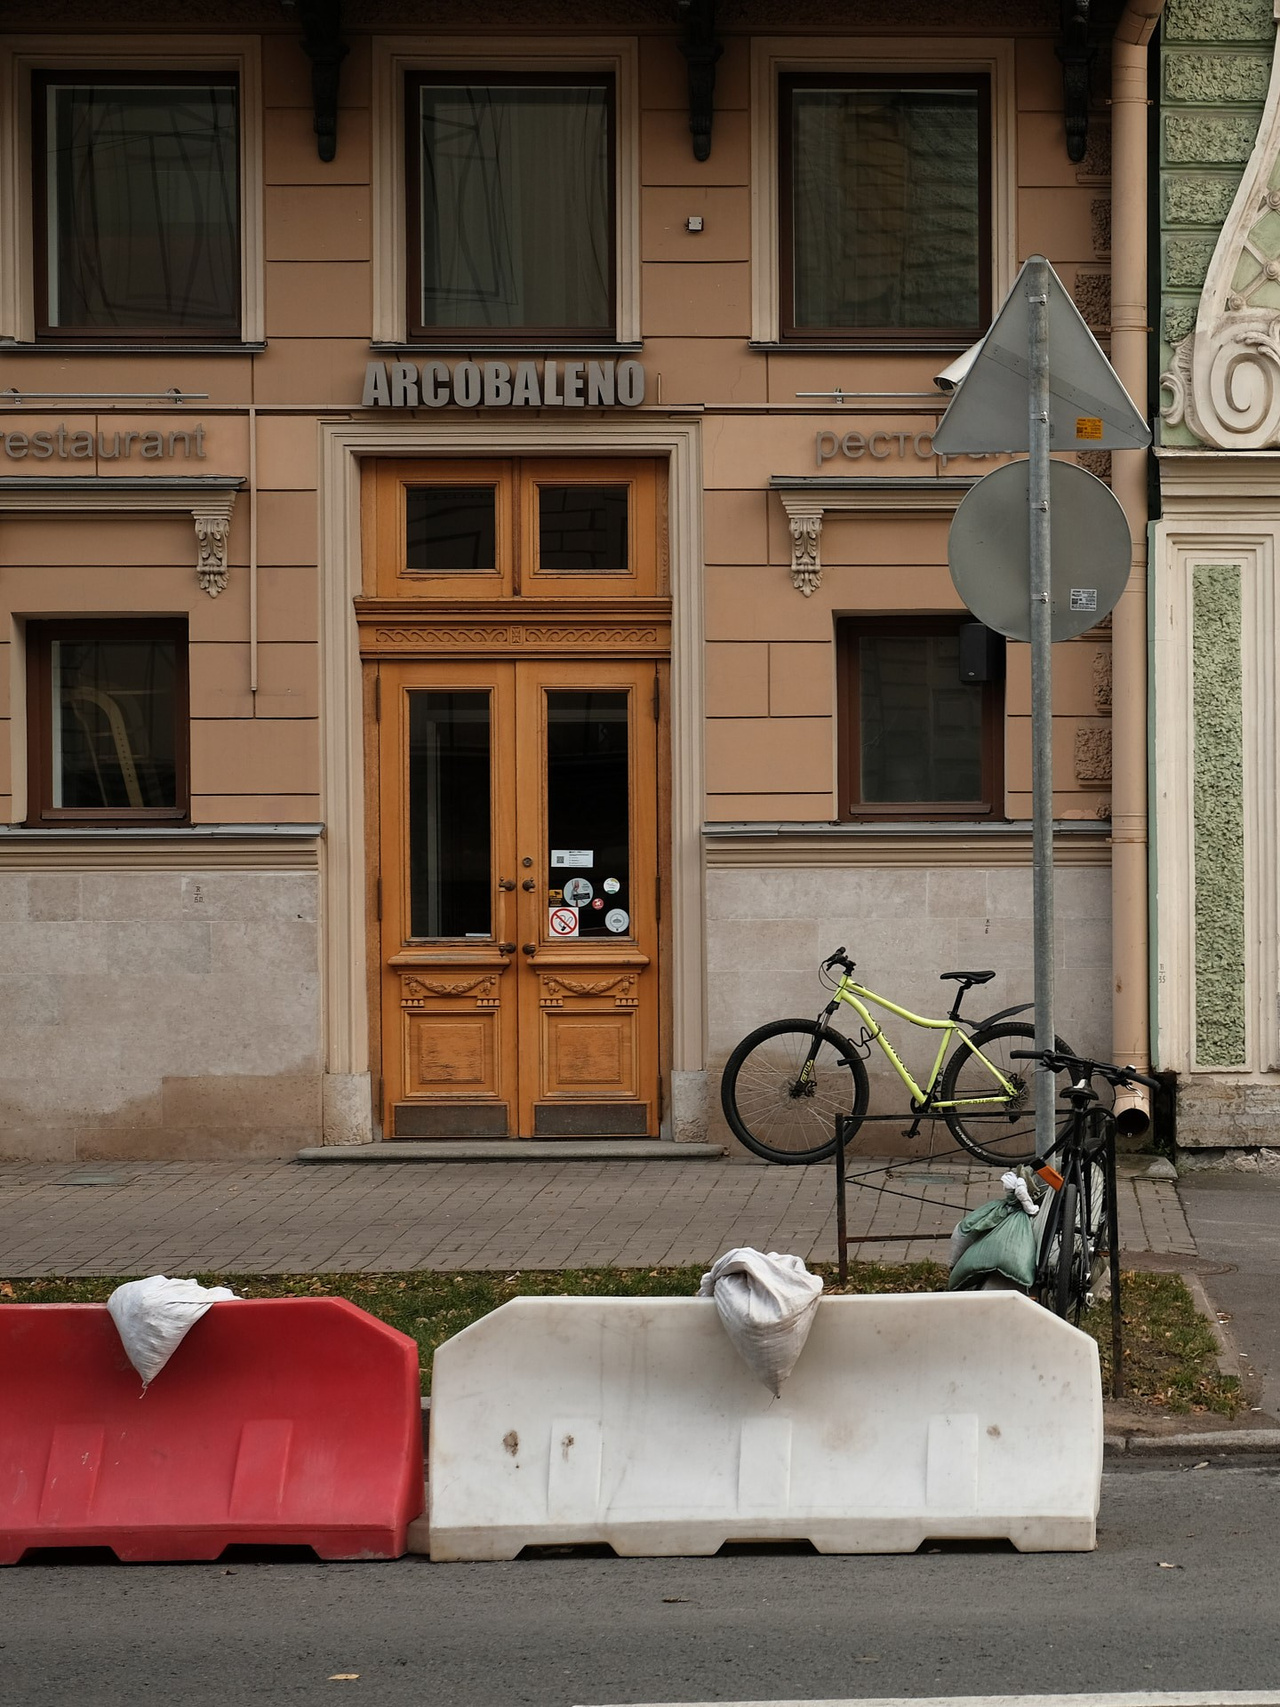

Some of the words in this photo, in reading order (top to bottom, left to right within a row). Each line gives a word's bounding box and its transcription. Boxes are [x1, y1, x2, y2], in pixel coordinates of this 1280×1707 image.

[361, 359, 645, 407] ARCOBALENO
[0, 422, 207, 459] estaurant
[815, 430, 1015, 467] ресто
